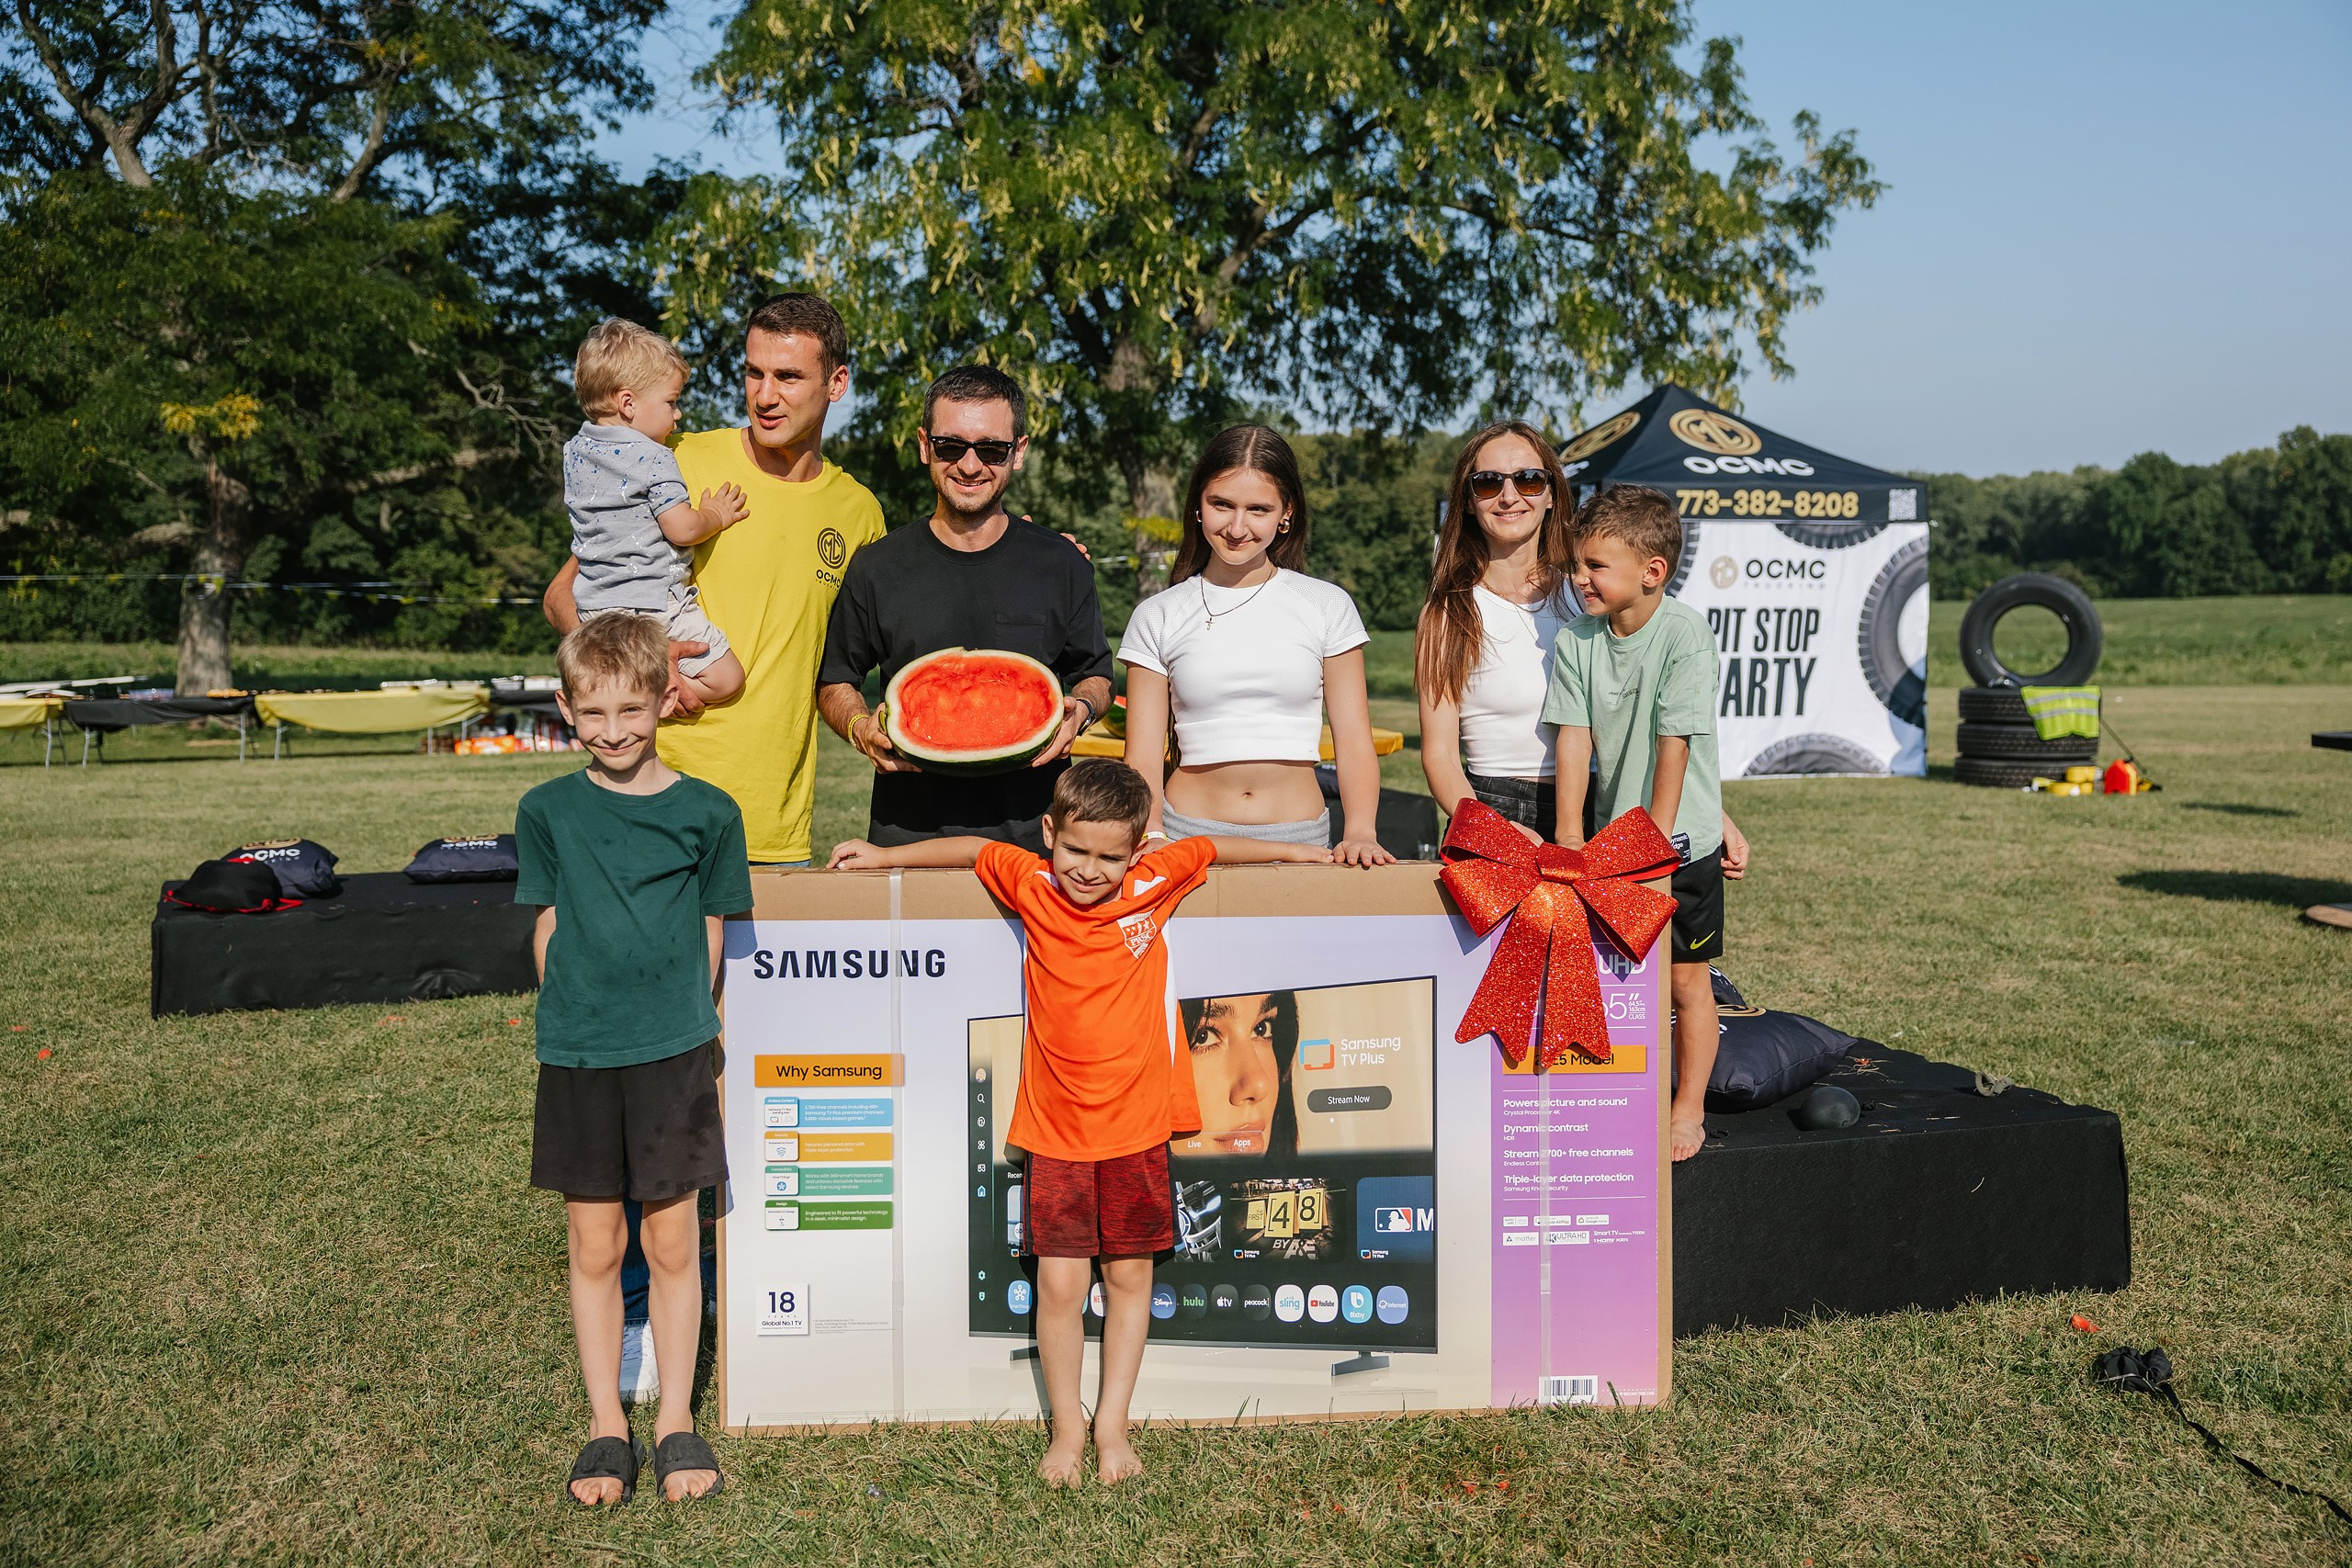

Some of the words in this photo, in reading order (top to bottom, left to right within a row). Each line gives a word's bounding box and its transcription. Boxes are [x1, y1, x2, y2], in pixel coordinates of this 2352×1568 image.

[1683, 457, 1815, 476] OCMC
[1676, 489, 1859, 518] 773-382-8208
[1746, 559, 1826, 579] OCMC
[816, 570, 841, 588] OCMC
[1708, 608, 1746, 652] PIT
[1754, 608, 1819, 652] STOP
[1720, 658, 1816, 716] ARTY
[753, 949, 945, 978] SAMSUNG
[1341, 1036, 1401, 1051] Samsung
[1341, 1054, 1357, 1066] TV
[1360, 1052, 1385, 1066] Plus
[1571, 1053, 1614, 1066] Model
[776, 1065, 808, 1080] Why
[813, 1065, 882, 1080] Samsung
[1328, 1095, 1352, 1104] Stream
[1354, 1095, 1370, 1103] Now
[1503, 1099, 1539, 1108] Powers
[1541, 1098, 1576, 1110] picture
[1577, 1098, 1597, 1107] and
[1598, 1097, 1628, 1106] sound
[1503, 1123, 1546, 1135] Dynamic
[1548, 1122, 1589, 1133] contrast
[1188, 1140, 1202, 1148] Live
[1233, 1138, 1251, 1147] Apps
[1503, 1149, 1539, 1158] Stream
[1568, 1148, 1589, 1156] free
[1590, 1147, 1634, 1156] channels
[1007, 1171, 1023, 1179] Recen
[1559, 1174, 1583, 1182] data
[1584, 1172, 1634, 1185] protection
[1272, 1239, 1290, 1249] BY
[1283, 1239, 1317, 1259] A&E
[768, 1292, 795, 1314] 18
[1093, 1295, 1108, 1303] NETF
[1182, 1296, 1204, 1306] hulu
[1223, 1297, 1232, 1307] tv
[1244, 1298, 1268, 1308] peacock
[1279, 1296, 1300, 1310] sling
[1350, 1311, 1365, 1320] Bixby
